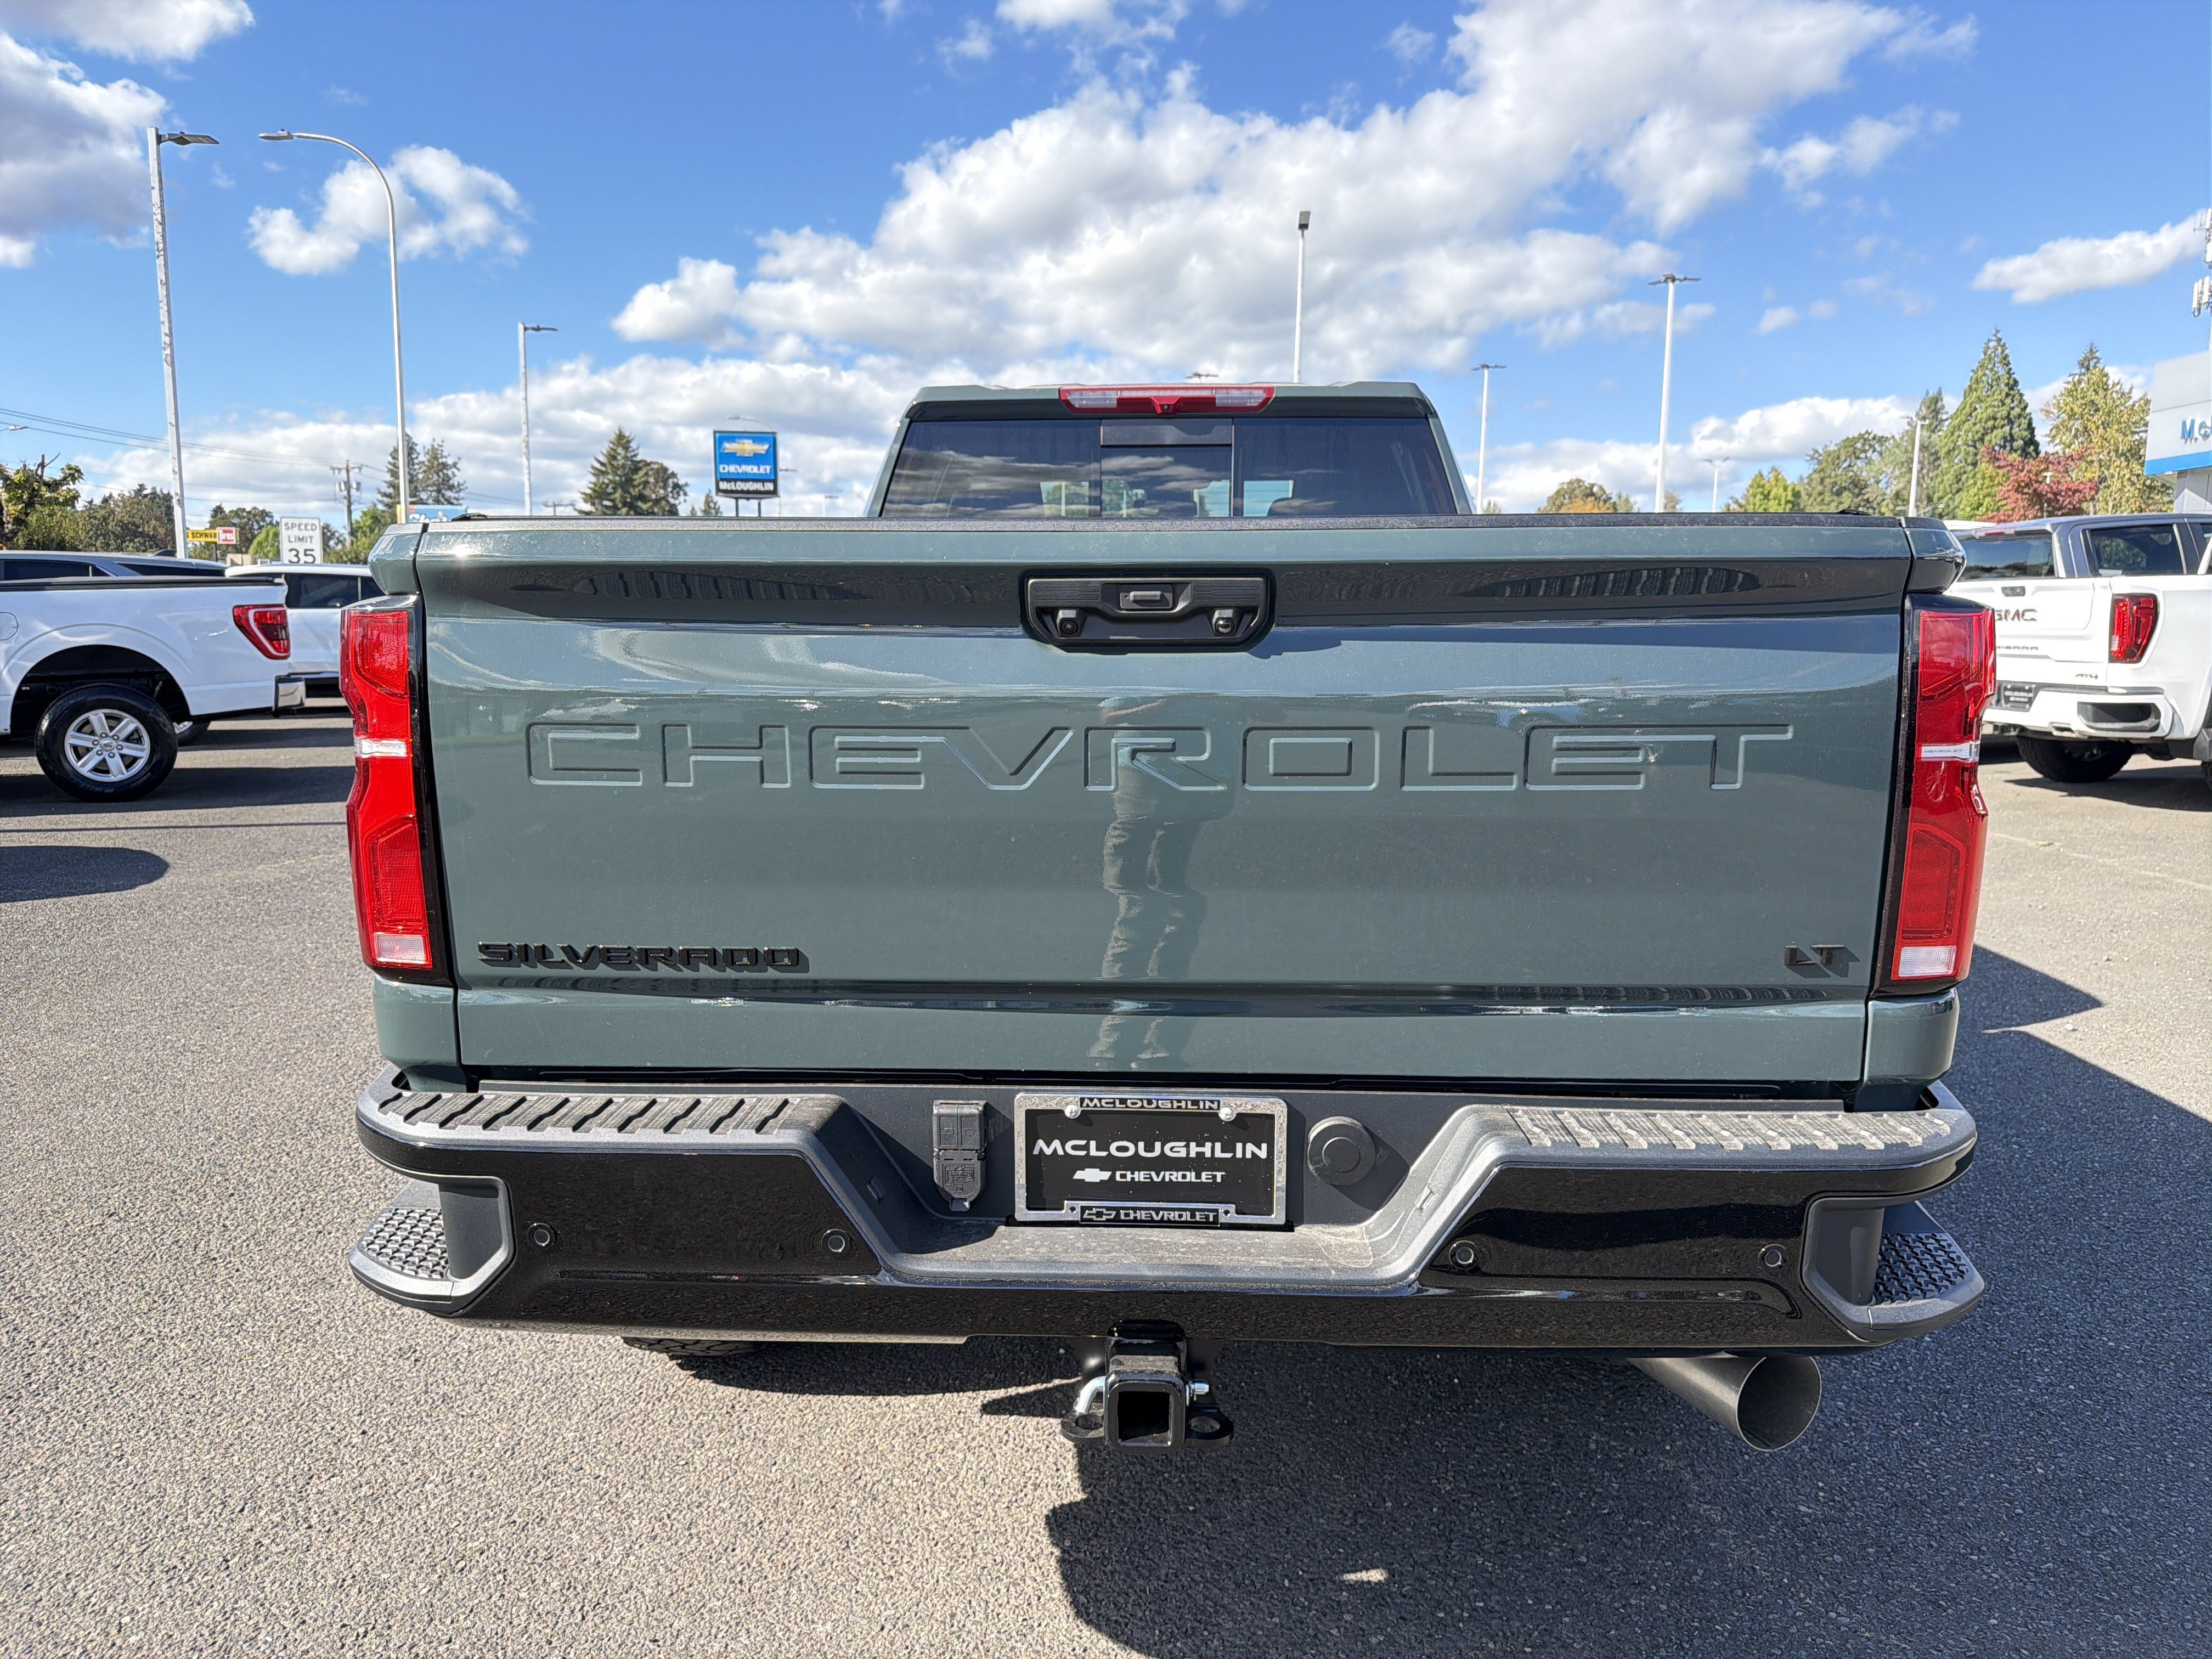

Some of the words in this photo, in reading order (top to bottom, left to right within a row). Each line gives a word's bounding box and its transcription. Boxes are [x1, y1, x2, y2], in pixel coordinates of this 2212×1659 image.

[719, 464, 771, 473] CHEVROLET
[284, 522, 317, 531] SPEED
[287, 535, 314, 544] LIMIT
[288, 549, 316, 564] 35
[527, 722, 1793, 791] CHEVROLET
[478, 941, 799, 967] SILVERADO
[1784, 944, 1846, 966] LT
[1082, 1098, 1218, 1110] MCLOUGHLIN
[1032, 1139, 1267, 1159] MCLOUGHLIN
[1115, 1171, 1225, 1183] CHEVROLET
[1120, 1210, 1217, 1222] CHEVROLET
